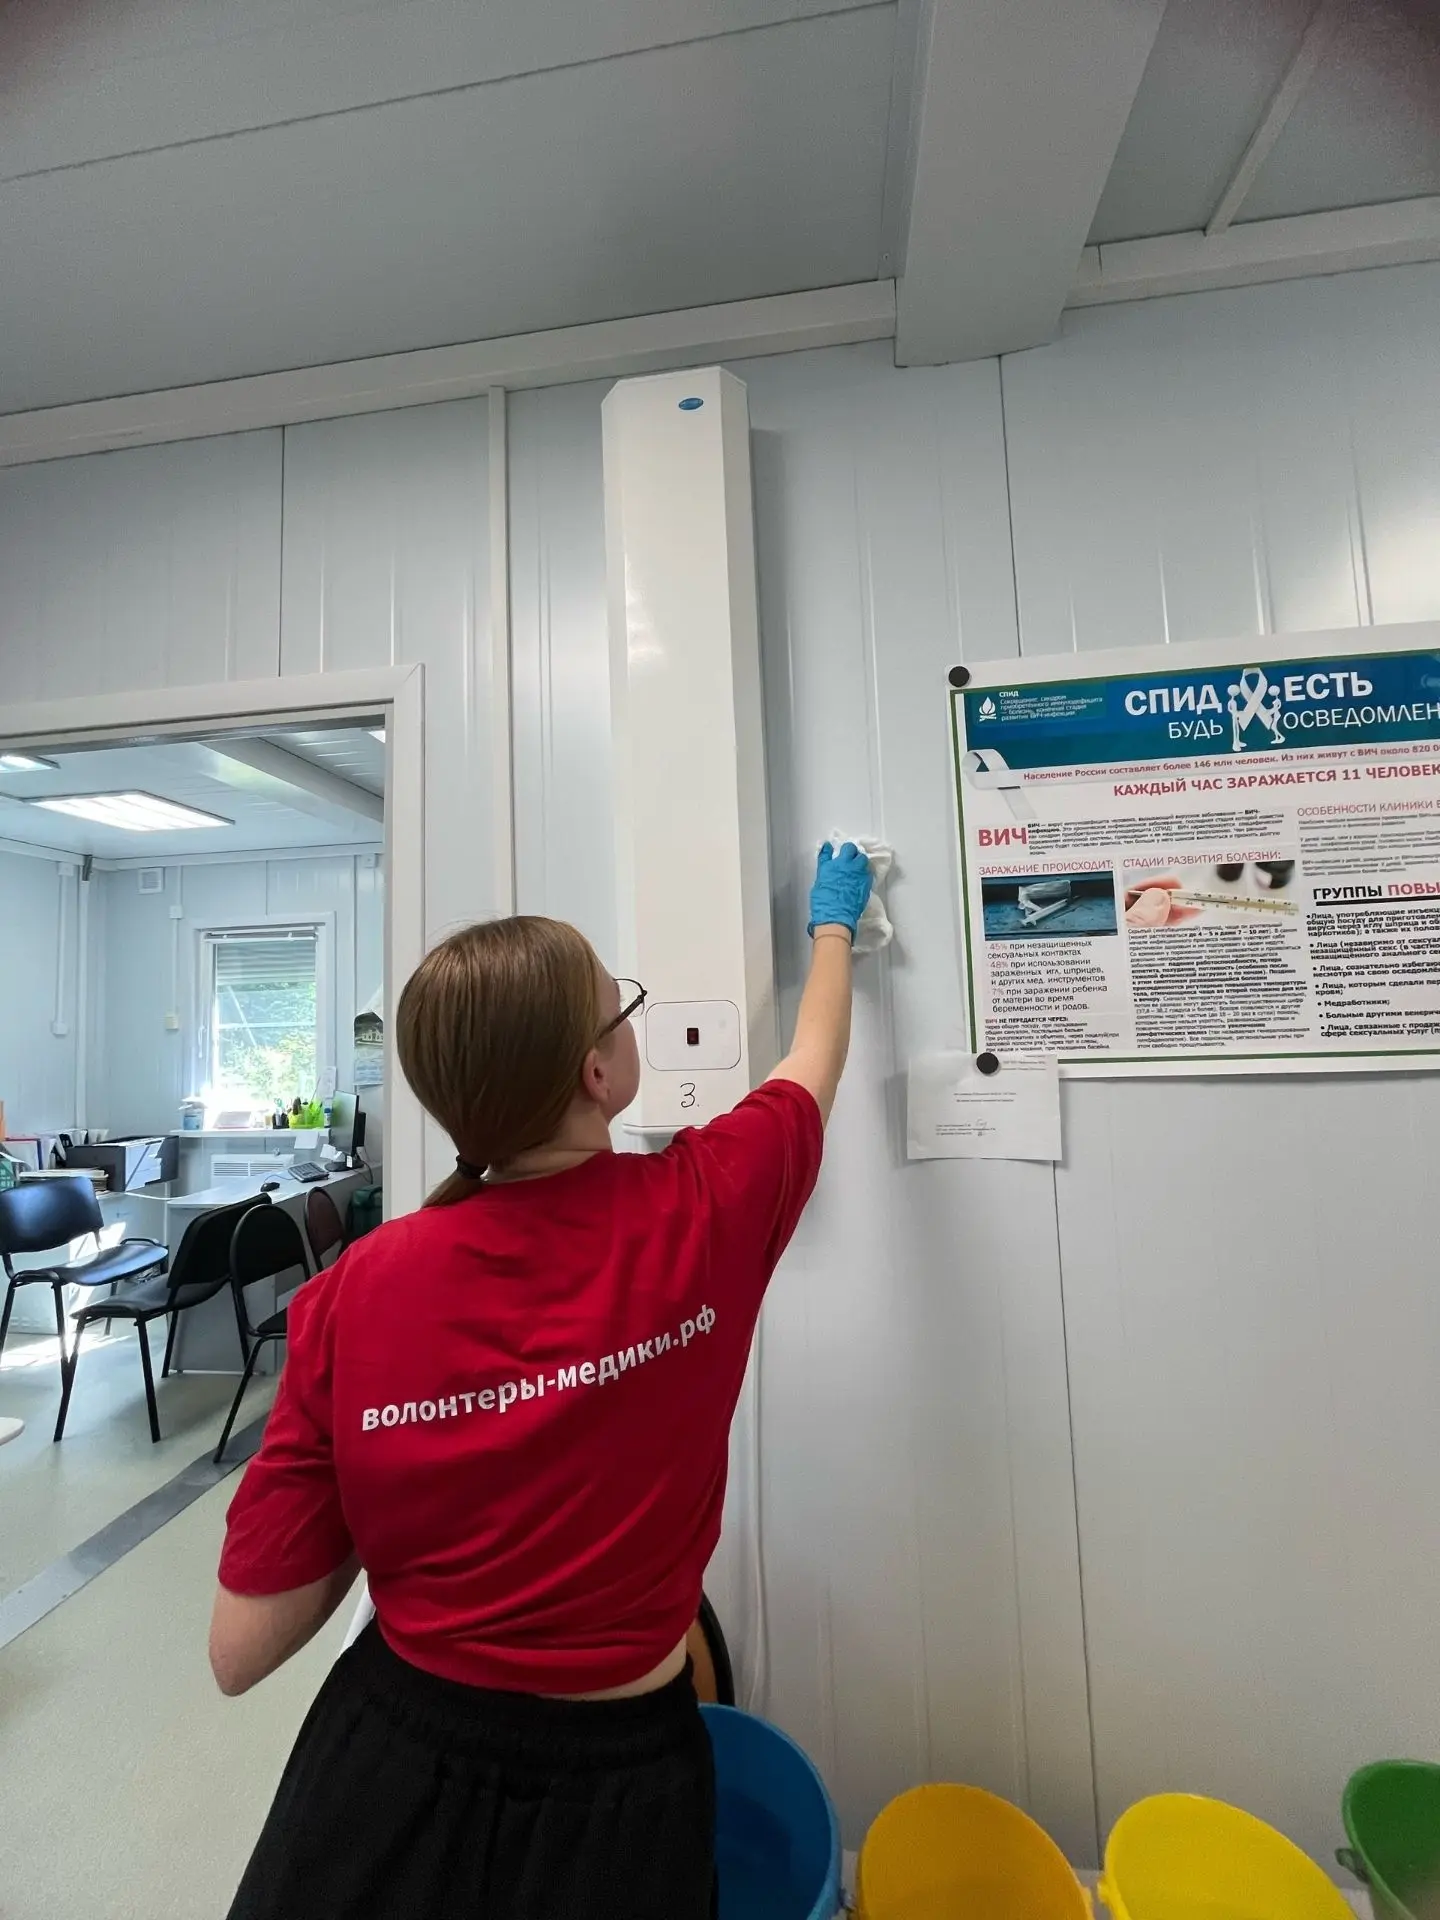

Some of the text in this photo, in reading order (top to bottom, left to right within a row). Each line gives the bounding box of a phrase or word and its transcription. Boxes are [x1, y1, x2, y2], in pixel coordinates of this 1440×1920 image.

[1125, 685, 1222, 715] СПИД
[1284, 672, 1373, 701] ЕСТЬ
[1168, 703, 1440, 740] БУДЬ ОСВЕДОМЛЕН
[1024, 770, 1072, 780] Население
[1075, 768, 1106, 777] России
[1109, 764, 1160, 775] составляет
[1163, 762, 1191, 770] более
[1194, 760, 1210, 768] 146
[1235, 756, 1278, 766] человек.
[1317, 752, 1347, 761] живут
[1358, 748, 1378, 756] ВИЧ
[1380, 747, 1410, 755] около
[1412, 745, 1430, 753] 820
[1114, 764, 1440, 796] КАЖДЫЙ ЧАС ЗАРАЖАЕТСЯ 11 ЧЕЛОВЕК
[1297, 804, 1376, 816] ОСОБЕННОСТИ
[1380, 801, 1433, 812] КЛИНИКИ
[978, 828, 1026, 846] ВИЧ
[1123, 851, 1281, 868] СТАДИИ РАЗВИТИЯ БОЛЕЗНИ:
[979, 860, 1114, 875] ЗАРАЖАНИЕ ПРОИСХОДИТ:
[1313, 882, 1440, 900] ГРУППЫ ПОВЫ
[1336, 910, 1406, 918] употребляющие
[1027, 941, 1092, 949] незащищенных
[988, 952, 1039, 960] сексуальных
[1028, 958, 1090, 967] использовании
[998, 978, 1024, 986] других
[1048, 975, 1106, 983] инструментов
[1024, 986, 1070, 994] заражении
[1072, 984, 1108, 992] ребенка
[992, 1004, 1052, 1012] беременности
[361, 1304, 716, 1431] волонтеры-медики.рф
